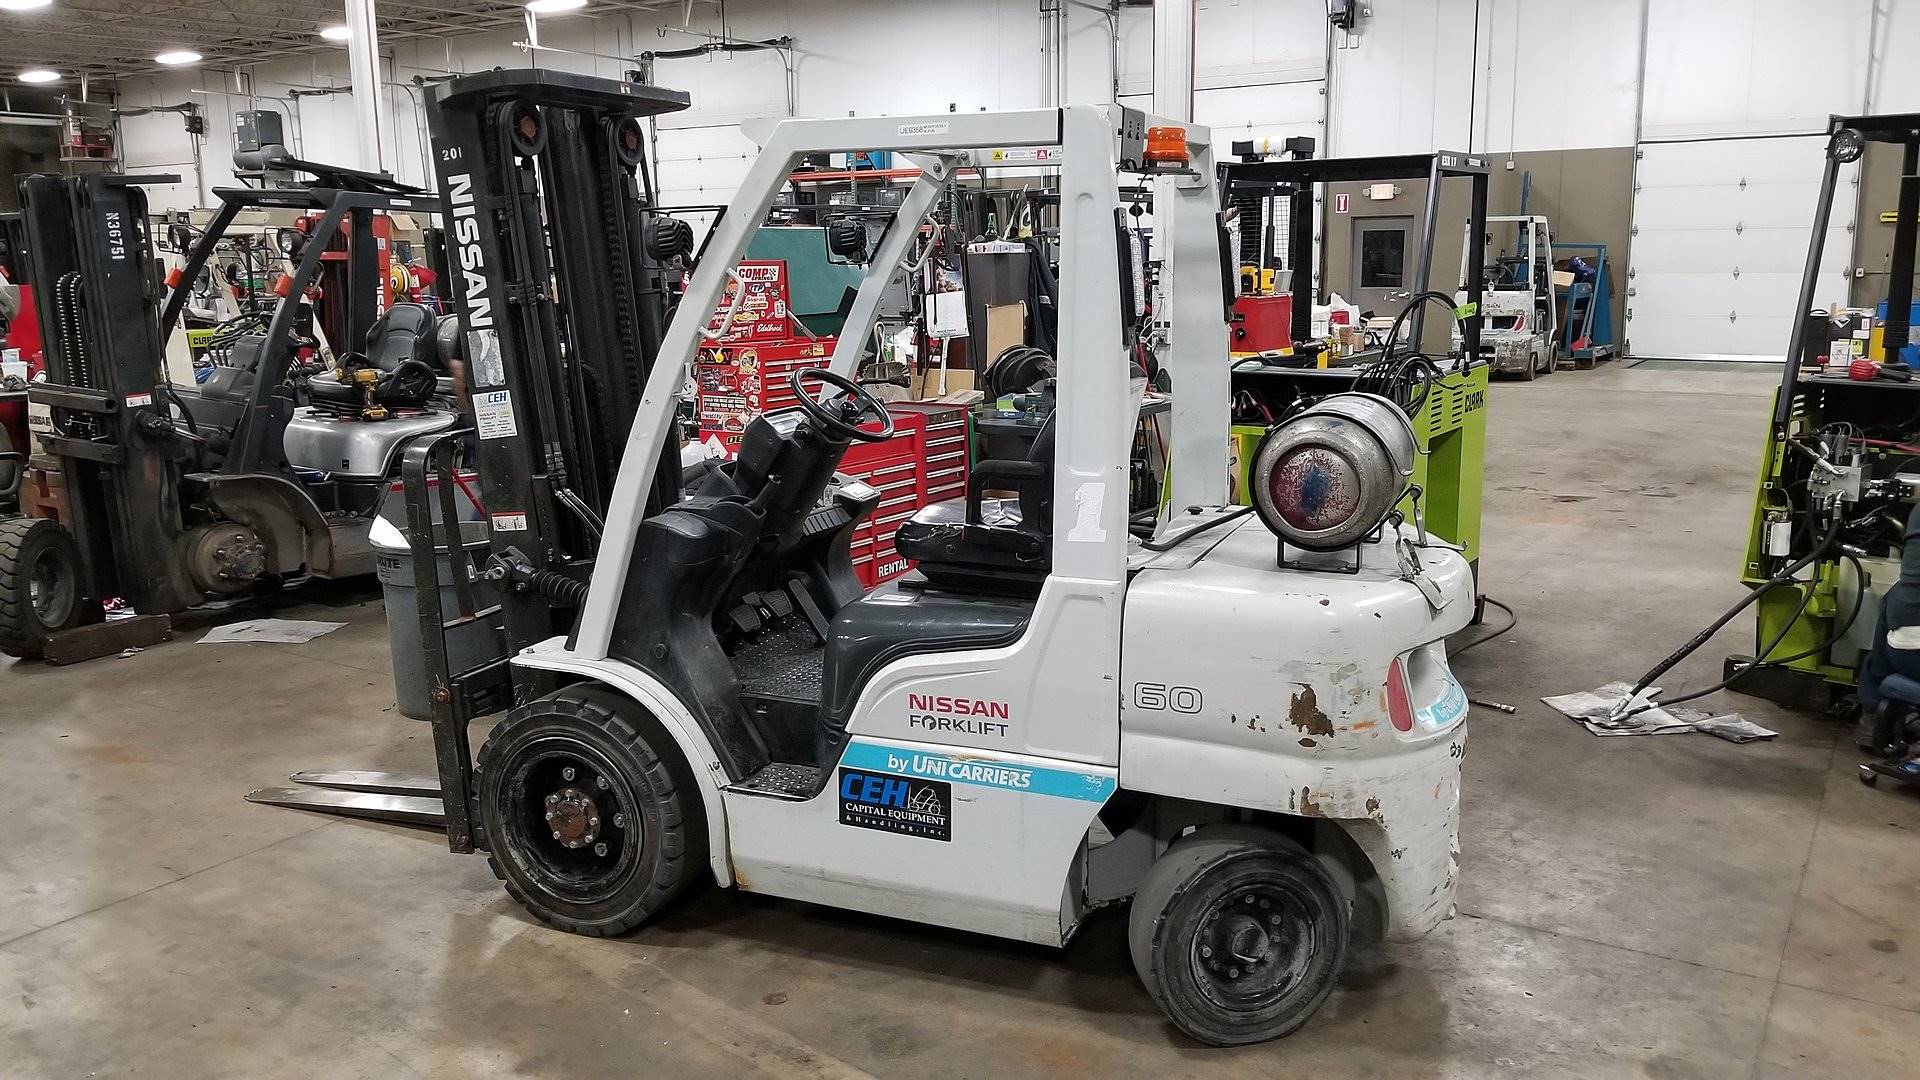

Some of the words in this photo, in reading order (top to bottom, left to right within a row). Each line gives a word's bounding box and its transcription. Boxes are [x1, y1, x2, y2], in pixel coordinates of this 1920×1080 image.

[105, 212, 125, 260] N36751
[448, 173, 493, 327] NISSAN
[739, 268, 769, 279] COMP
[488, 392, 507, 404] CEH
[1464, 390, 1484, 413] CLARK
[1067, 483, 1107, 542] 1
[878, 558, 909, 578] RENTAL
[909, 693, 1009, 719] NISSAN
[1134, 682, 1203, 714] 60
[909, 715, 1009, 737] FORKLIFT
[888, 754, 909, 773] by
[841, 772, 909, 808] CEH
[845, 803, 887, 816] CAPITAL
[888, 809, 946, 826] EQUIPMENT
